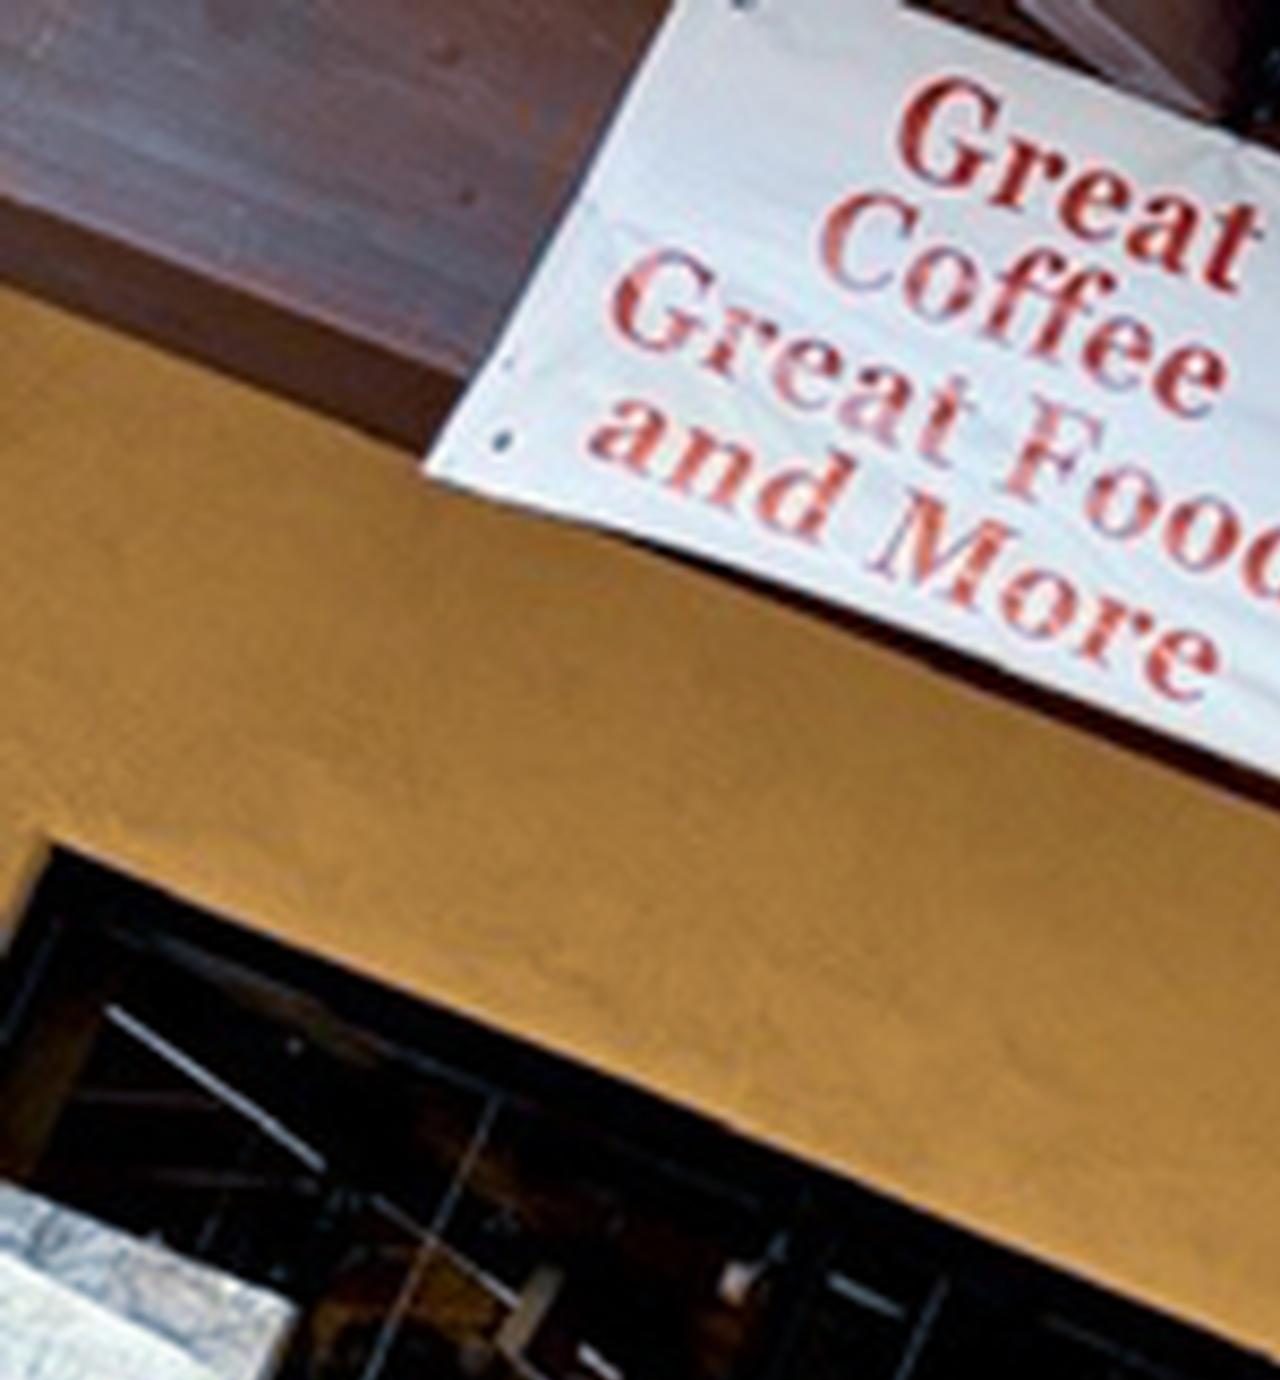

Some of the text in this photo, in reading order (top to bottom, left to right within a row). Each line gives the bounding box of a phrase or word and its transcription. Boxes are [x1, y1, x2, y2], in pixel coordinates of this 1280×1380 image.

[896, 72, 1264, 299] Great
[610, 247, 974, 470] Great
[816, 190, 1229, 422] Coffee
[586, 391, 1224, 706] and More
